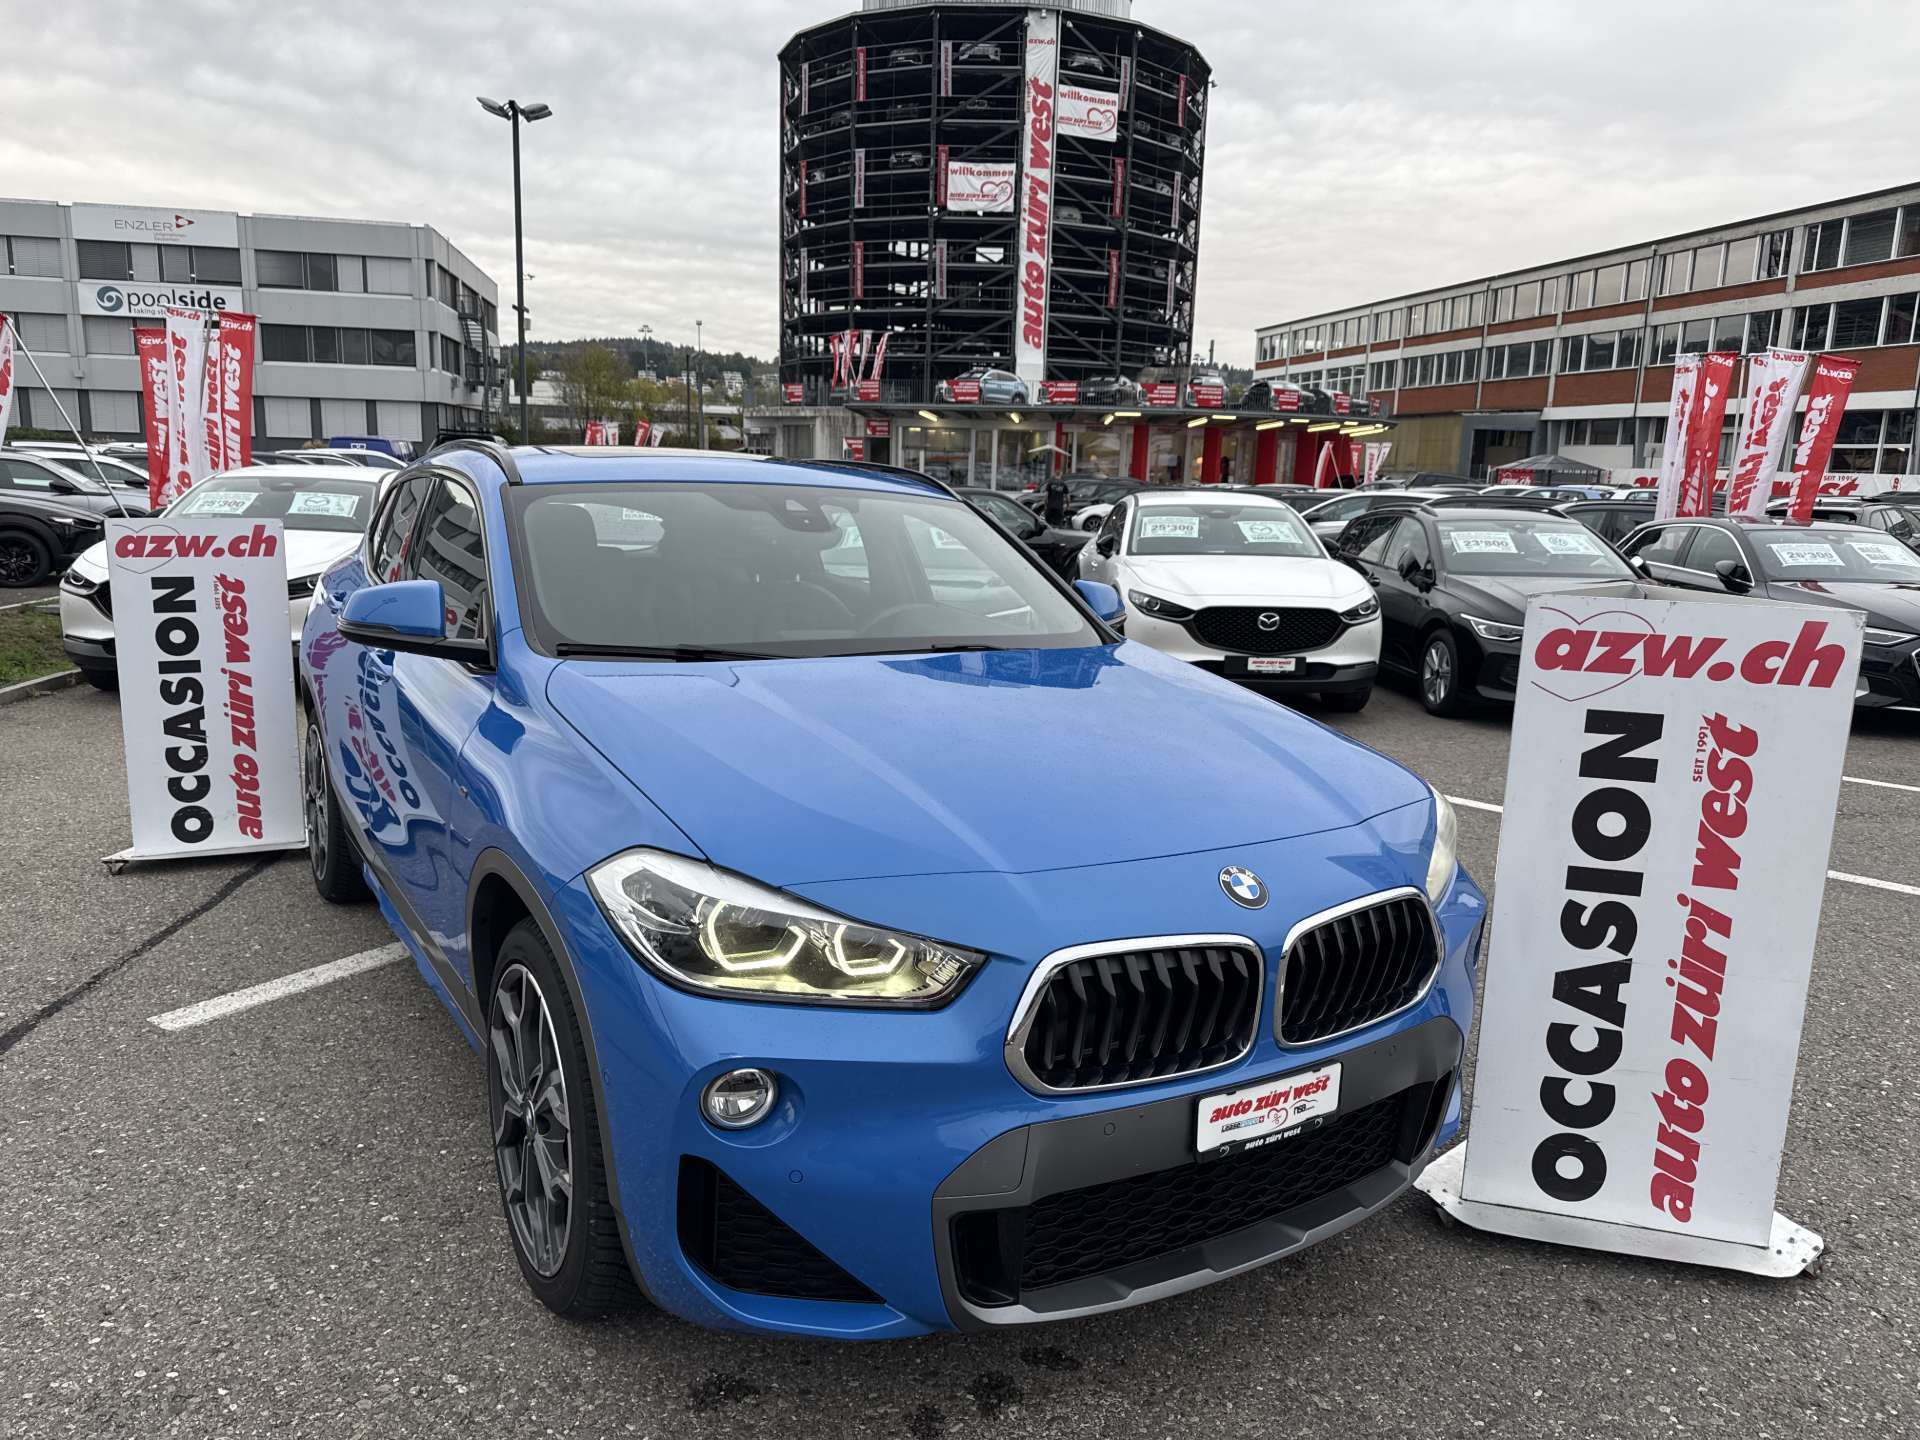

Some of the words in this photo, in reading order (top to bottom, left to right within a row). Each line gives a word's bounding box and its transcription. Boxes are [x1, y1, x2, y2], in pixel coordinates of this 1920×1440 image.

[1028, 38, 1056, 46] azw.ch
[1028, 76, 1053, 169] west
[1059, 90, 1117, 107] willkommen
[950, 166, 1014, 177] willkommen
[114, 219, 173, 232] ENZLER
[1022, 172, 1050, 260] züri
[127, 289, 227, 313] poolside
[1021, 261, 1045, 349] auto
[223, 342, 242, 411] west
[115, 524, 278, 558] azw.ch
[215, 572, 250, 663] west
[1534, 620, 1846, 689] azw.ch
[151, 576, 214, 844] OCCASION
[221, 667, 257, 752] züri
[1696, 726, 1710, 755] 1991
[229, 753, 264, 840] auto
[1691, 712, 1759, 890] west
[1692, 758, 1706, 782] SEIT
[1531, 708, 1665, 1202] OCCASION
[1665, 892, 1734, 1062] züri
[1209, 1098, 1253, 1123] auto
[1252, 1085, 1293, 1112] züri
[1293, 1075, 1331, 1101] west
[1244, 1138, 1264, 1150] auto
[1265, 1132, 1282, 1145] züri
[1283, 1126, 1302, 1140] west
[1650, 1057, 1710, 1223] auto
